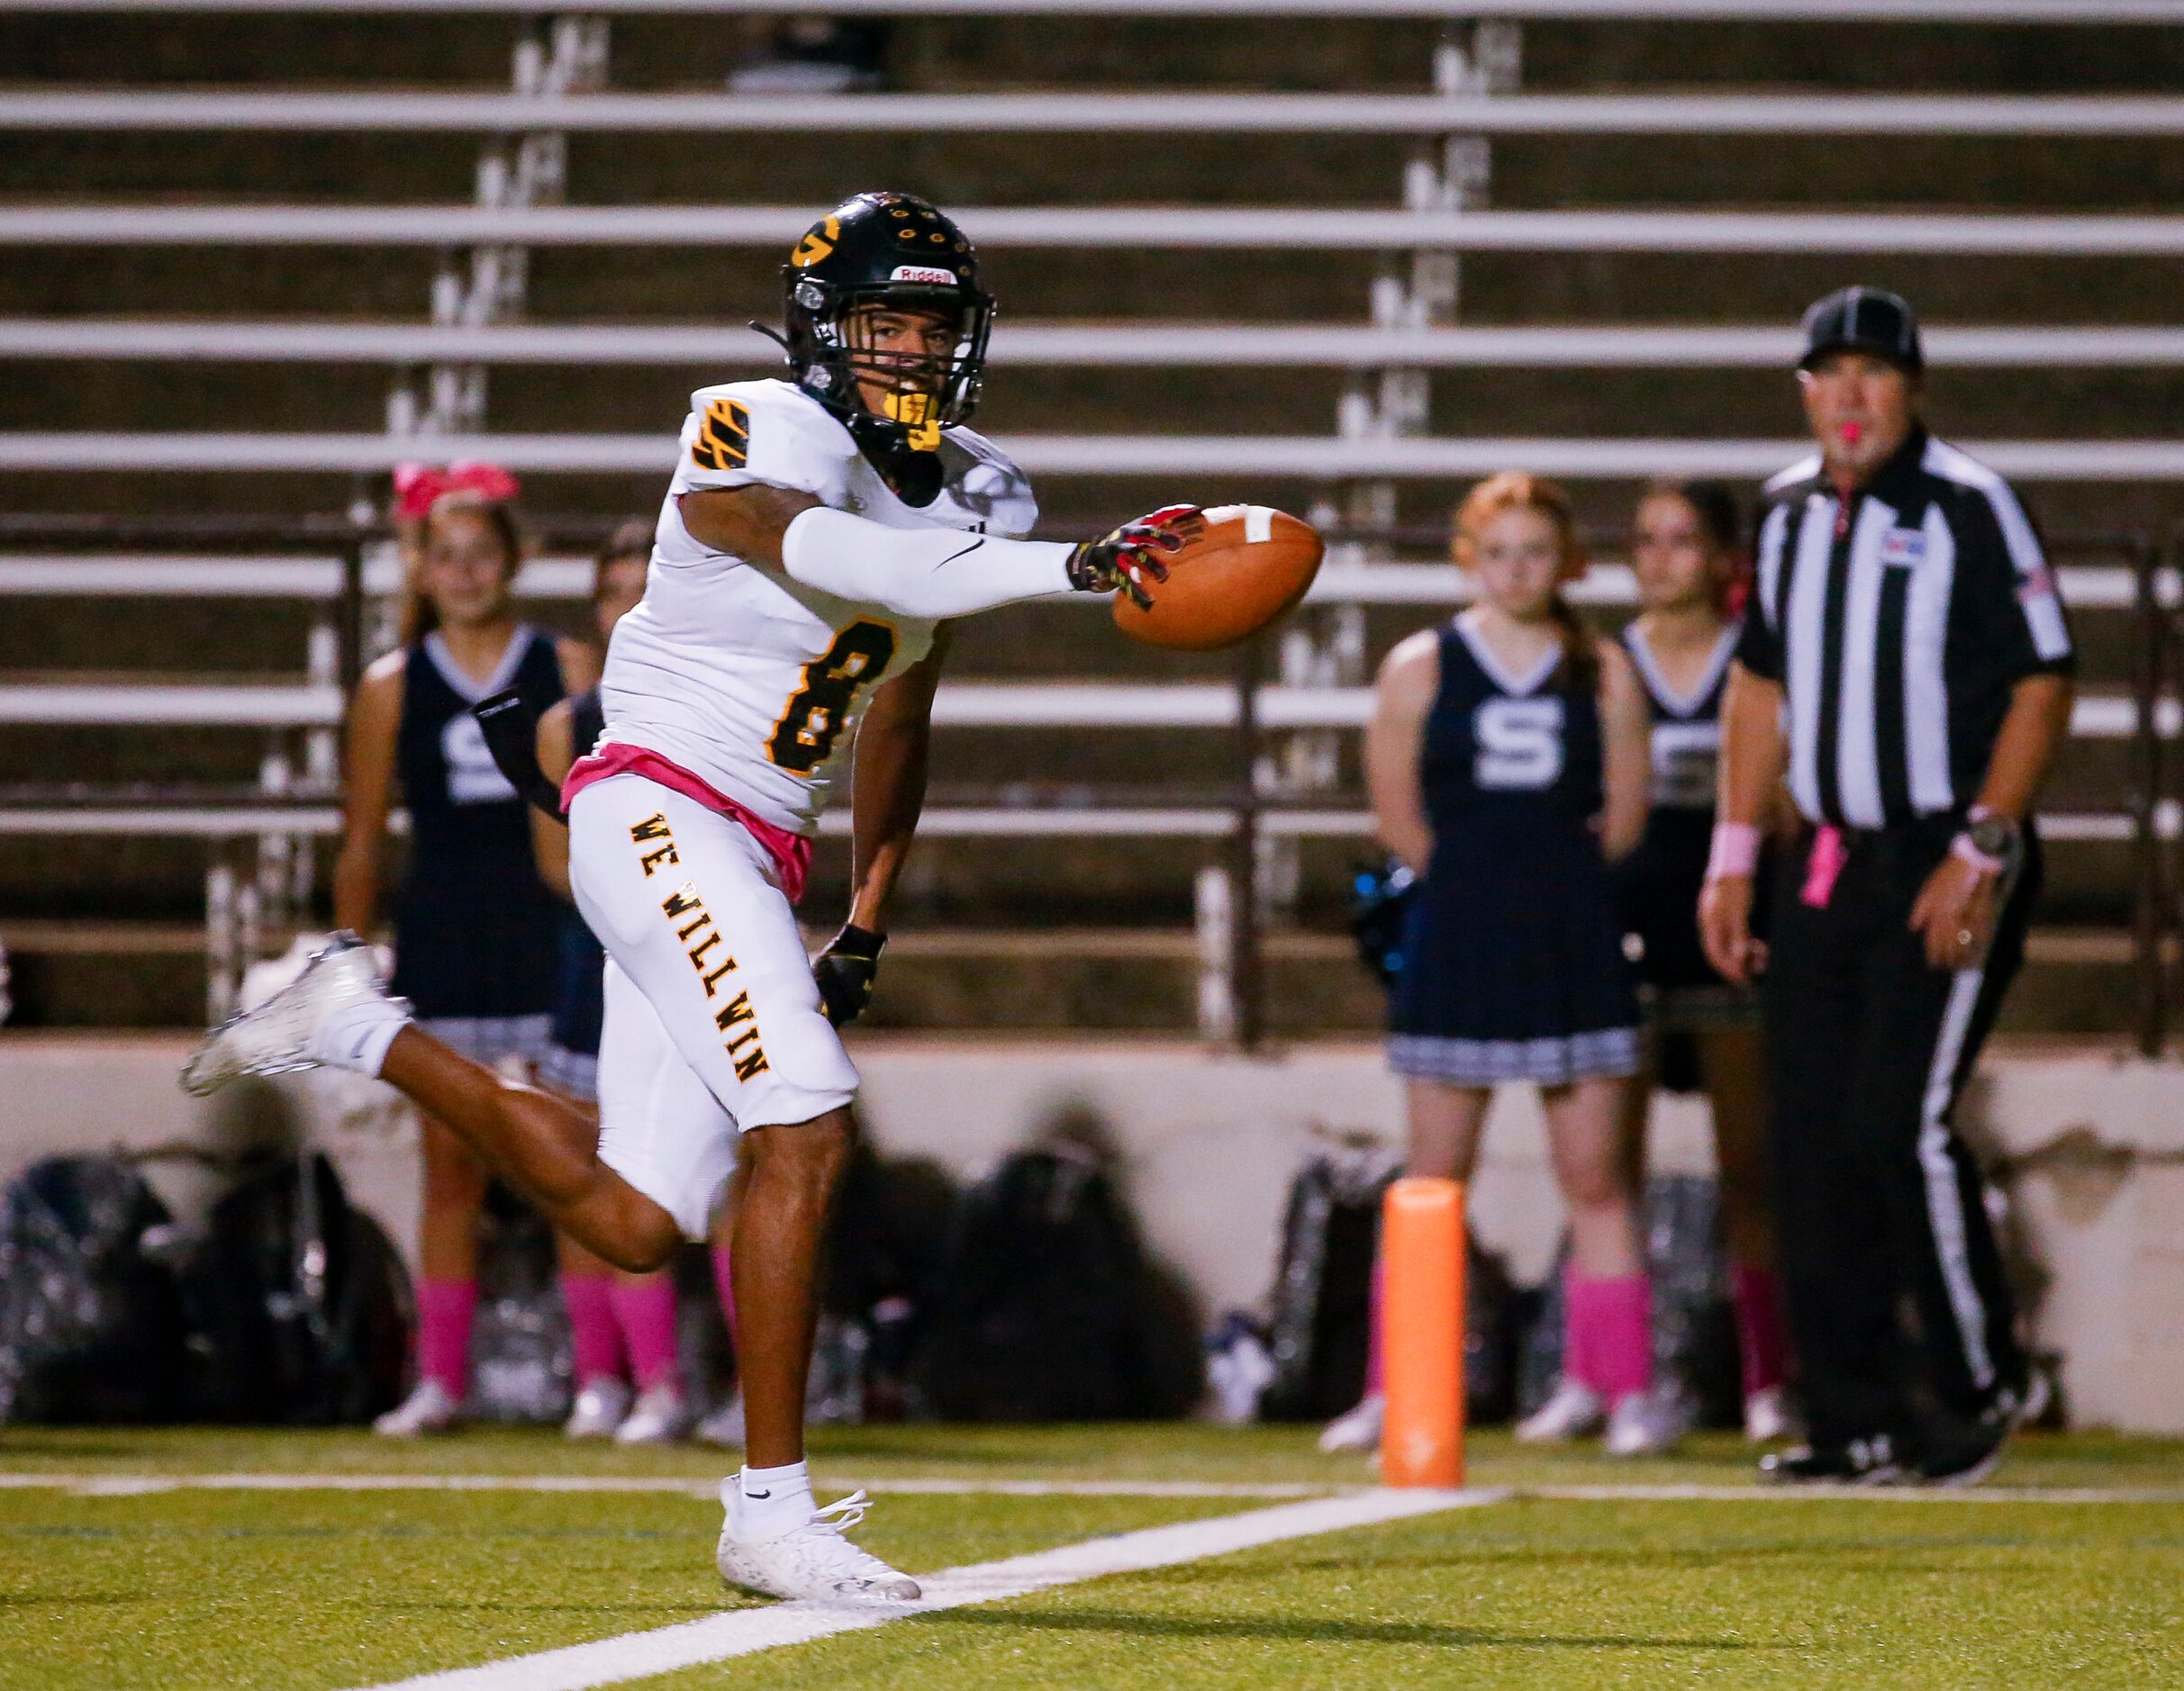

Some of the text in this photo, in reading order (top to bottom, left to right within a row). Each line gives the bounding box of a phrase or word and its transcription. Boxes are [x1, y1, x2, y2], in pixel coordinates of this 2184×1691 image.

[902, 268, 951, 285] Riddell
[765, 615, 899, 778] 8
[1473, 694, 1565, 791] S
[630, 809, 771, 1084] WE WILL WIN
